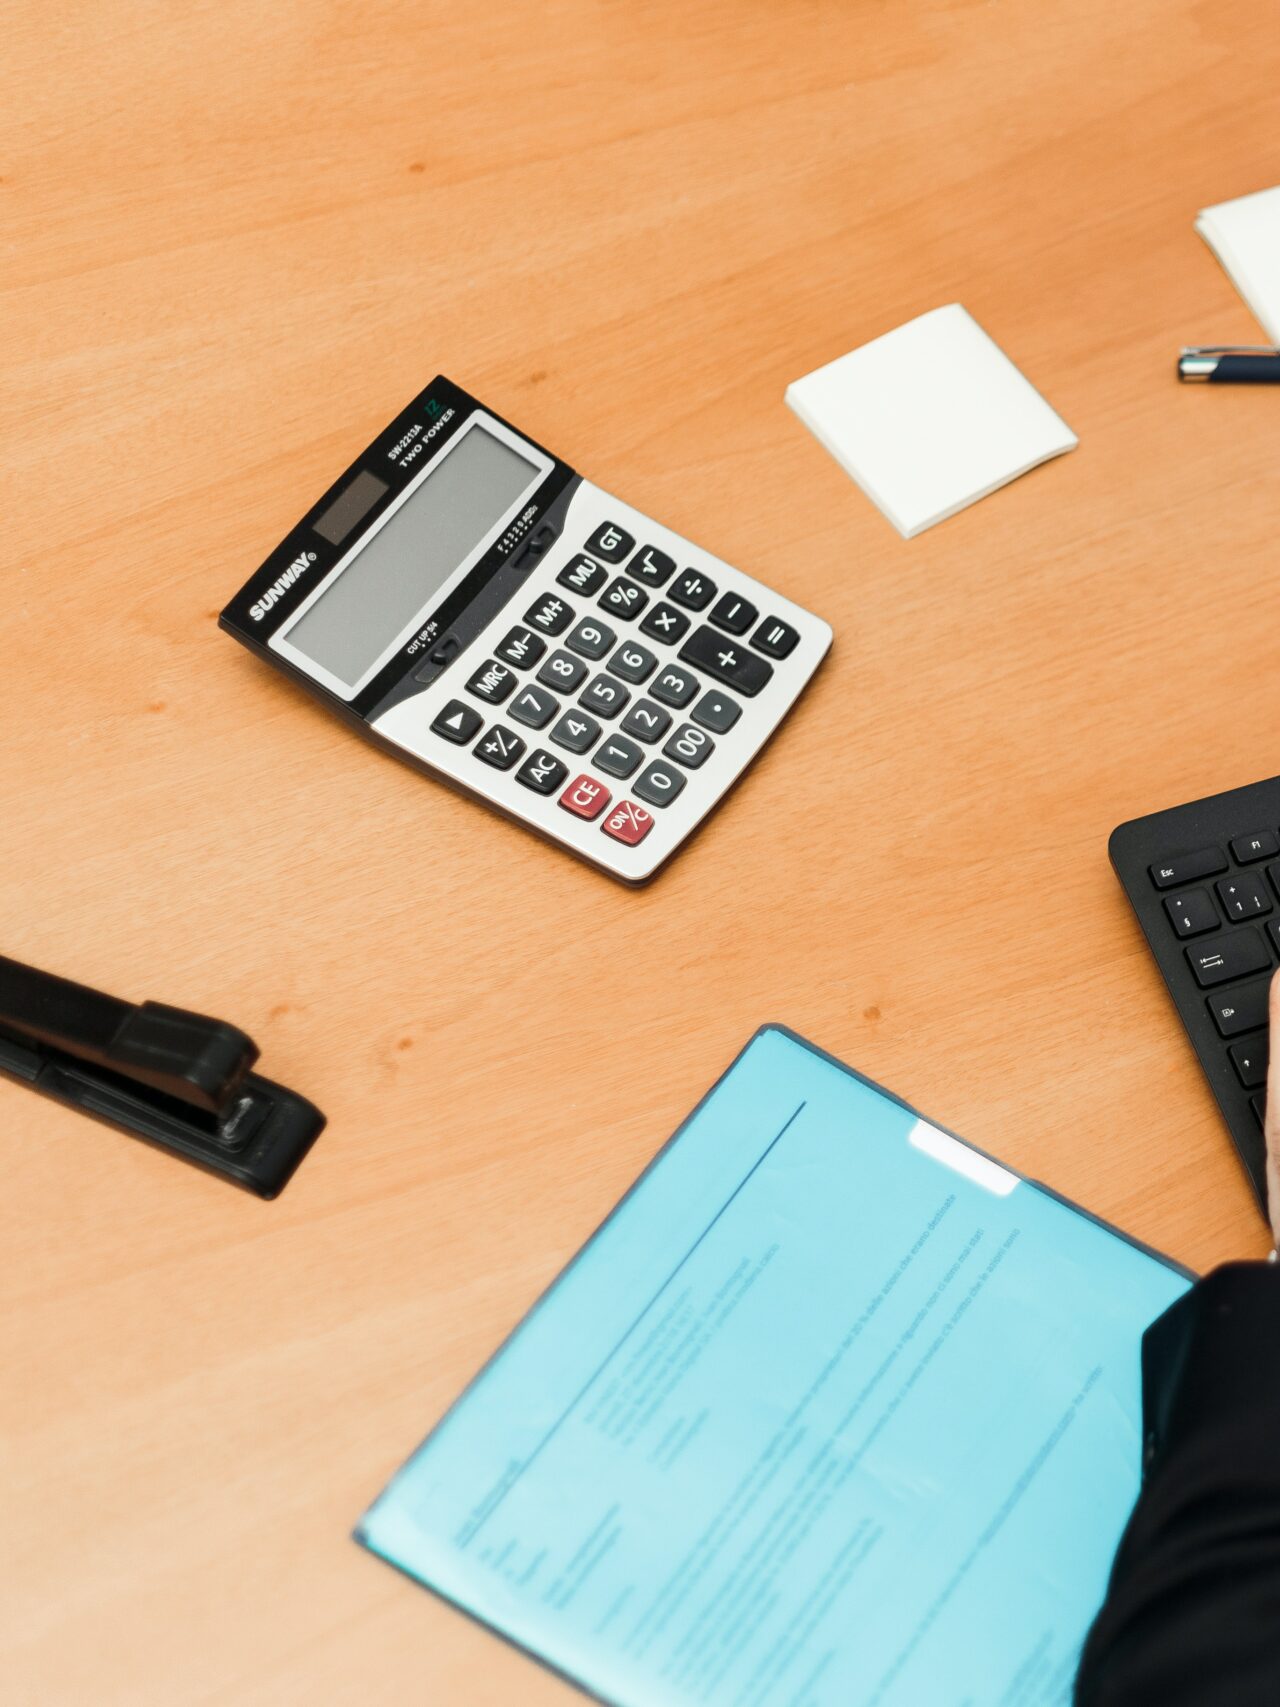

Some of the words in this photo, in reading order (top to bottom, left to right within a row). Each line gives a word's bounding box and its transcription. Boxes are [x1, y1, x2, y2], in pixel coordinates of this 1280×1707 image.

[388, 424, 422, 460] SW-2213A
[400, 444, 422, 467] TWO
[422, 408, 455, 444] POWER
[600, 527, 622, 550] GT
[569, 559, 596, 586] MU
[250, 552, 310, 620] SUNWAY
[610, 586, 638, 605] %
[536, 601, 562, 625] M+
[408, 639, 421, 654] CUT
[418, 630, 428, 641] UP
[581, 627, 601, 644] 9
[552, 659, 574, 676] 8
[623, 650, 643, 667] 6
[477, 664, 508, 693] MRC
[663, 675, 684, 692] 3
[521, 694, 541, 711] 7
[593, 683, 615, 701] 5
[567, 719, 587, 736] 4
[635, 710, 658, 727] 2
[609, 746, 628, 758] 1
[676, 729, 705, 756] 00
[530, 756, 556, 783] AC
[650, 773, 671, 789] 0
[573, 782, 599, 805] CE
[609, 801, 649, 830] ON/C
[1252, 841, 1260, 849] F1
[1161, 869, 1174, 877] Esc
[1236, 902, 1242, 910] 1
[1184, 918, 1190, 927] §
[900, 1254, 913, 1270] che
[911, 1230, 930, 1255] erano
[928, 1194, 957, 1231] destinate
[944, 1262, 961, 1284] sono
[958, 1246, 972, 1263] mai
[969, 1228, 985, 1247] stati
[969, 1281, 983, 1297] che
[986, 1248, 1007, 1273] azioni
[1003, 1228, 1021, 1249] sono
